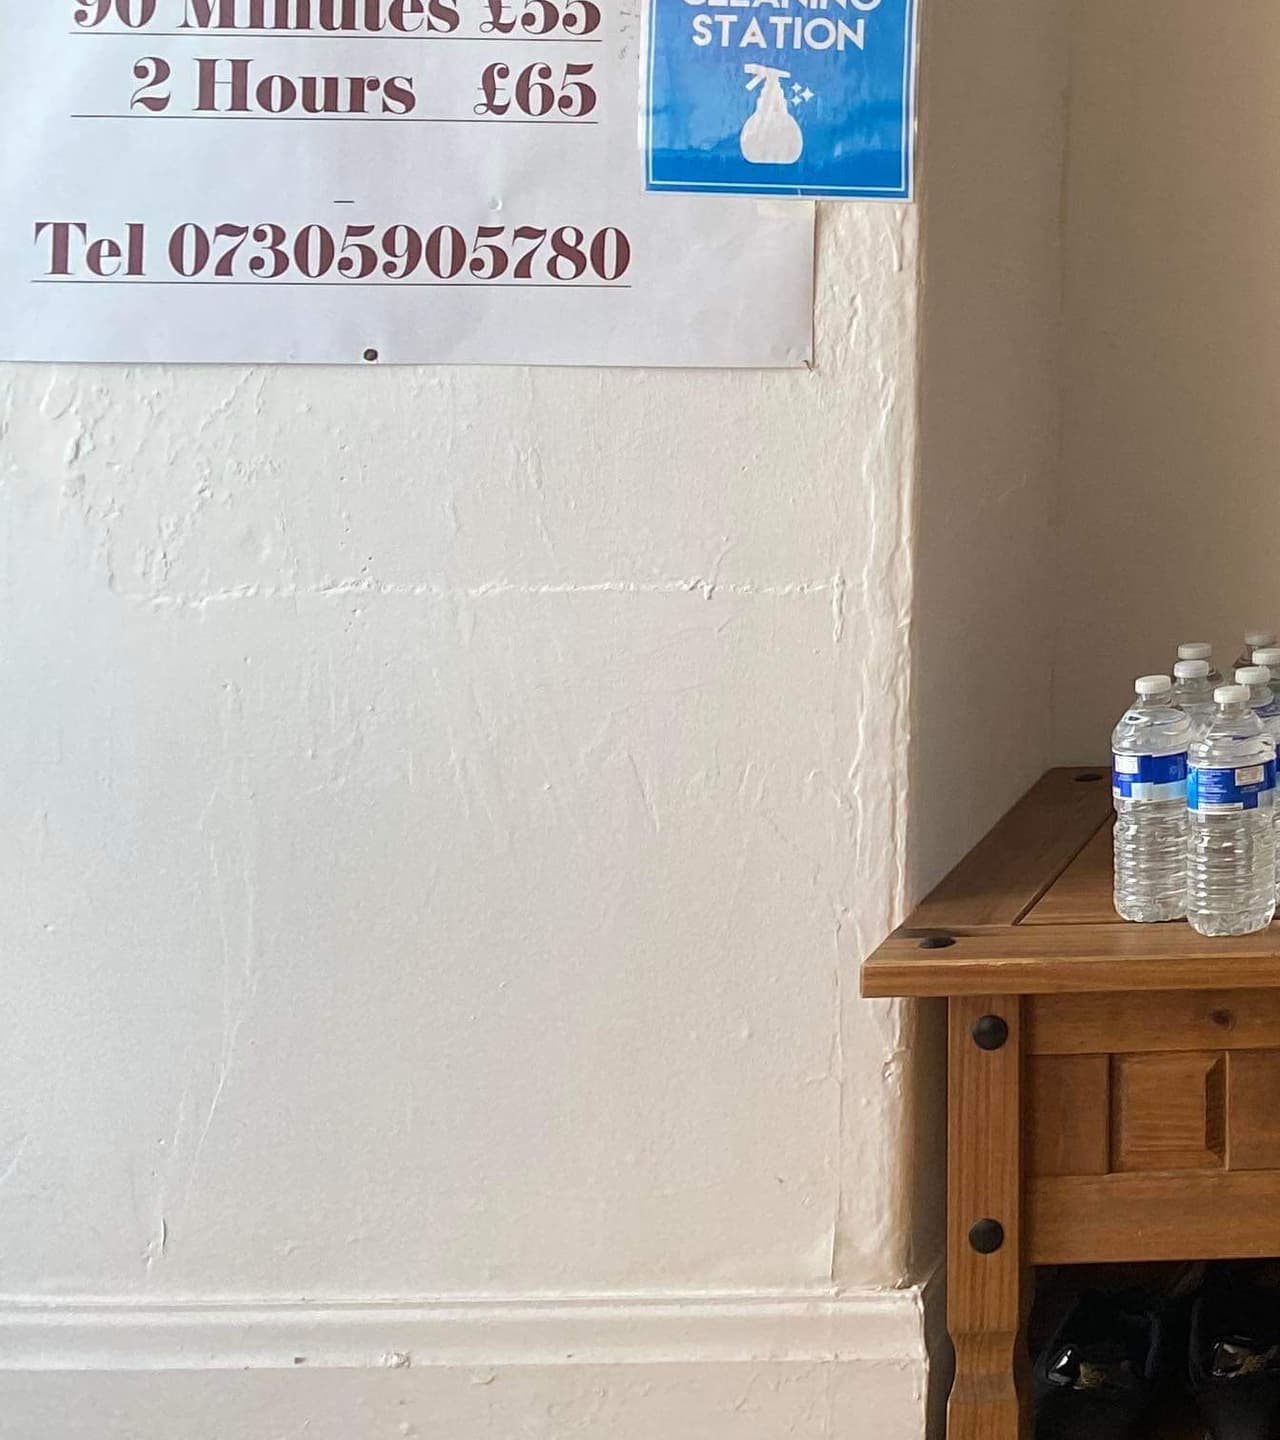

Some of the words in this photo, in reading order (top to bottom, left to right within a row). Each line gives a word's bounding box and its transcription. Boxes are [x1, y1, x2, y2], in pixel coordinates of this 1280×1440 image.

[692, 14, 866, 50] STATION
[131, 56, 171, 112] 2
[193, 57, 418, 114] Hours
[473, 62, 598, 119] £65
[33, 222, 146, 277] Tel
[168, 223, 633, 280] 07305905780
